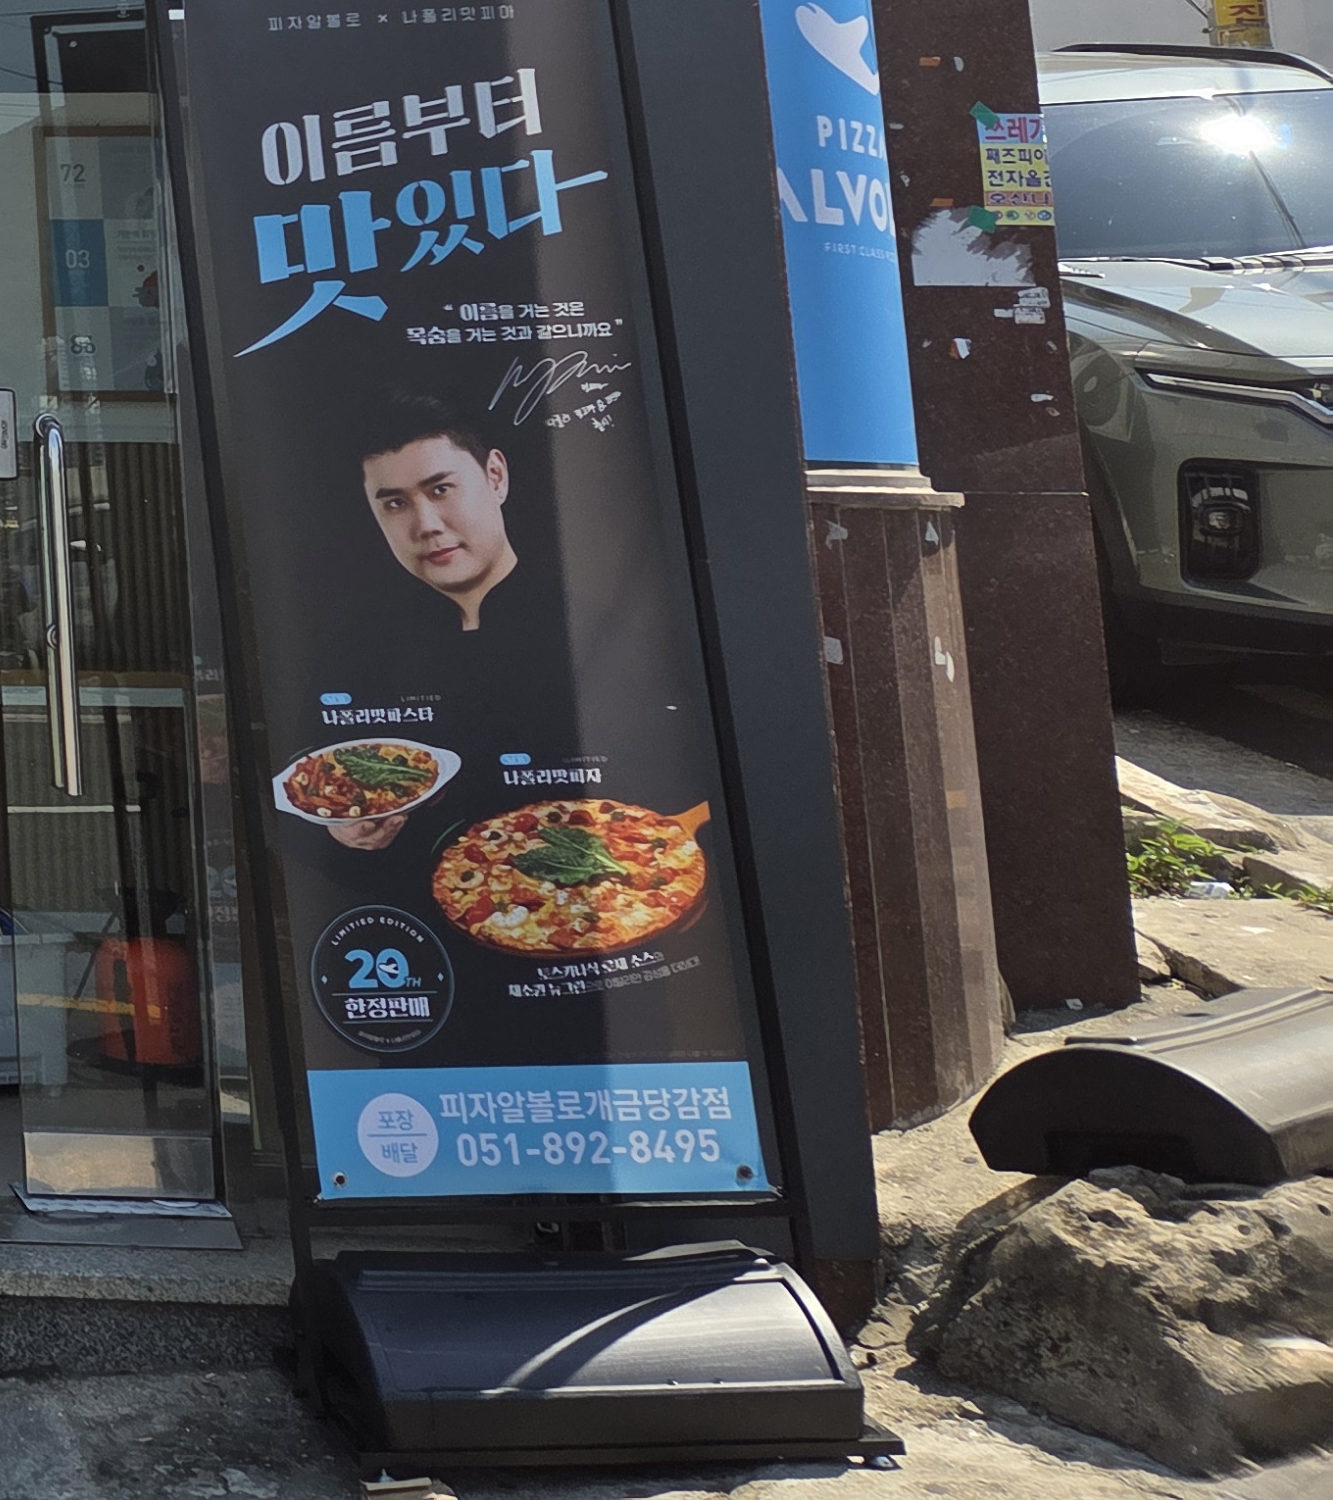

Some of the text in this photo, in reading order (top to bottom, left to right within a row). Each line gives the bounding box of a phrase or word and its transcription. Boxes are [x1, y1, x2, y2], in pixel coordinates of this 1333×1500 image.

[267, 11, 362, 31] 피자알볼로
[261, 68, 542, 186] 이름부터
[60, 164, 86, 183] 72
[233, 149, 609, 358] 맛있다
[331, 916, 425, 946] LIMITED EDITION
[344, 996, 431, 1020] 한정판매
[438, 1085, 733, 1126] 피자알볼로개금당감점
[376, 1108, 415, 1132] 포장
[380, 1141, 420, 1166] 배달
[455, 1128, 722, 1168] 051-892-8495
